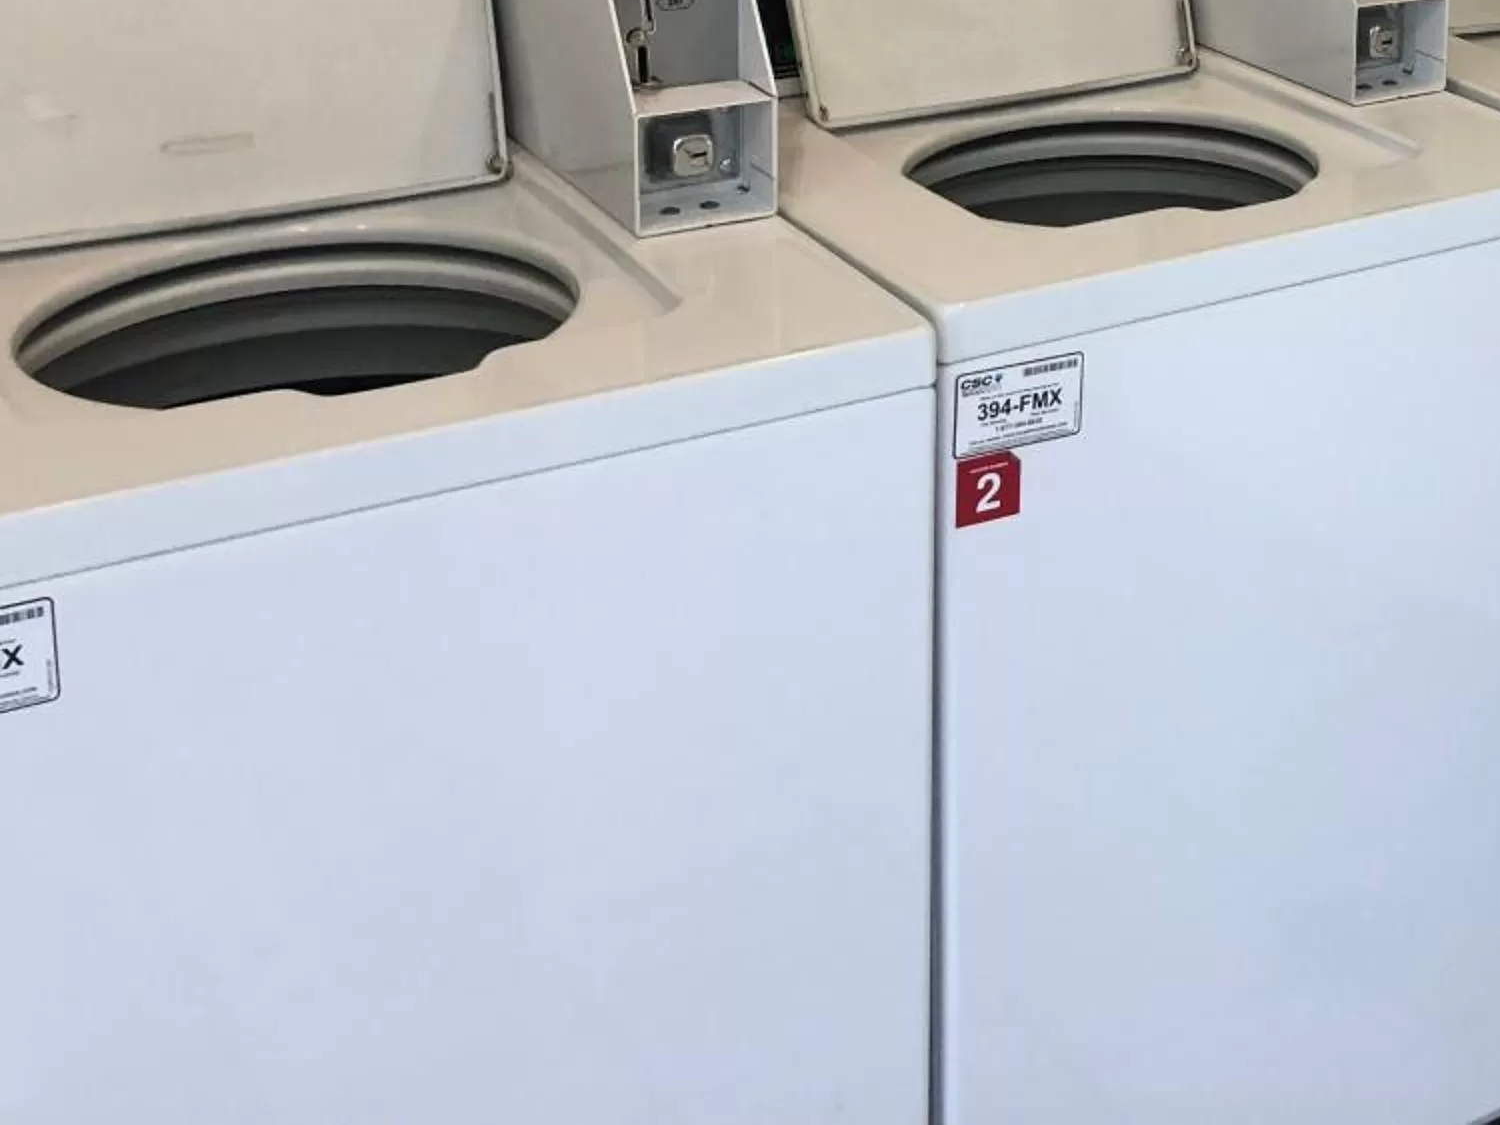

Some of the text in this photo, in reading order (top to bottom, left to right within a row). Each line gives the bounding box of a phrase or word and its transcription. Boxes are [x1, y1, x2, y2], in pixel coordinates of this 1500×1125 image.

[961, 376, 994, 391] CSC
[977, 387, 1064, 422] 394-FMX
[976, 472, 1003, 514] 2
